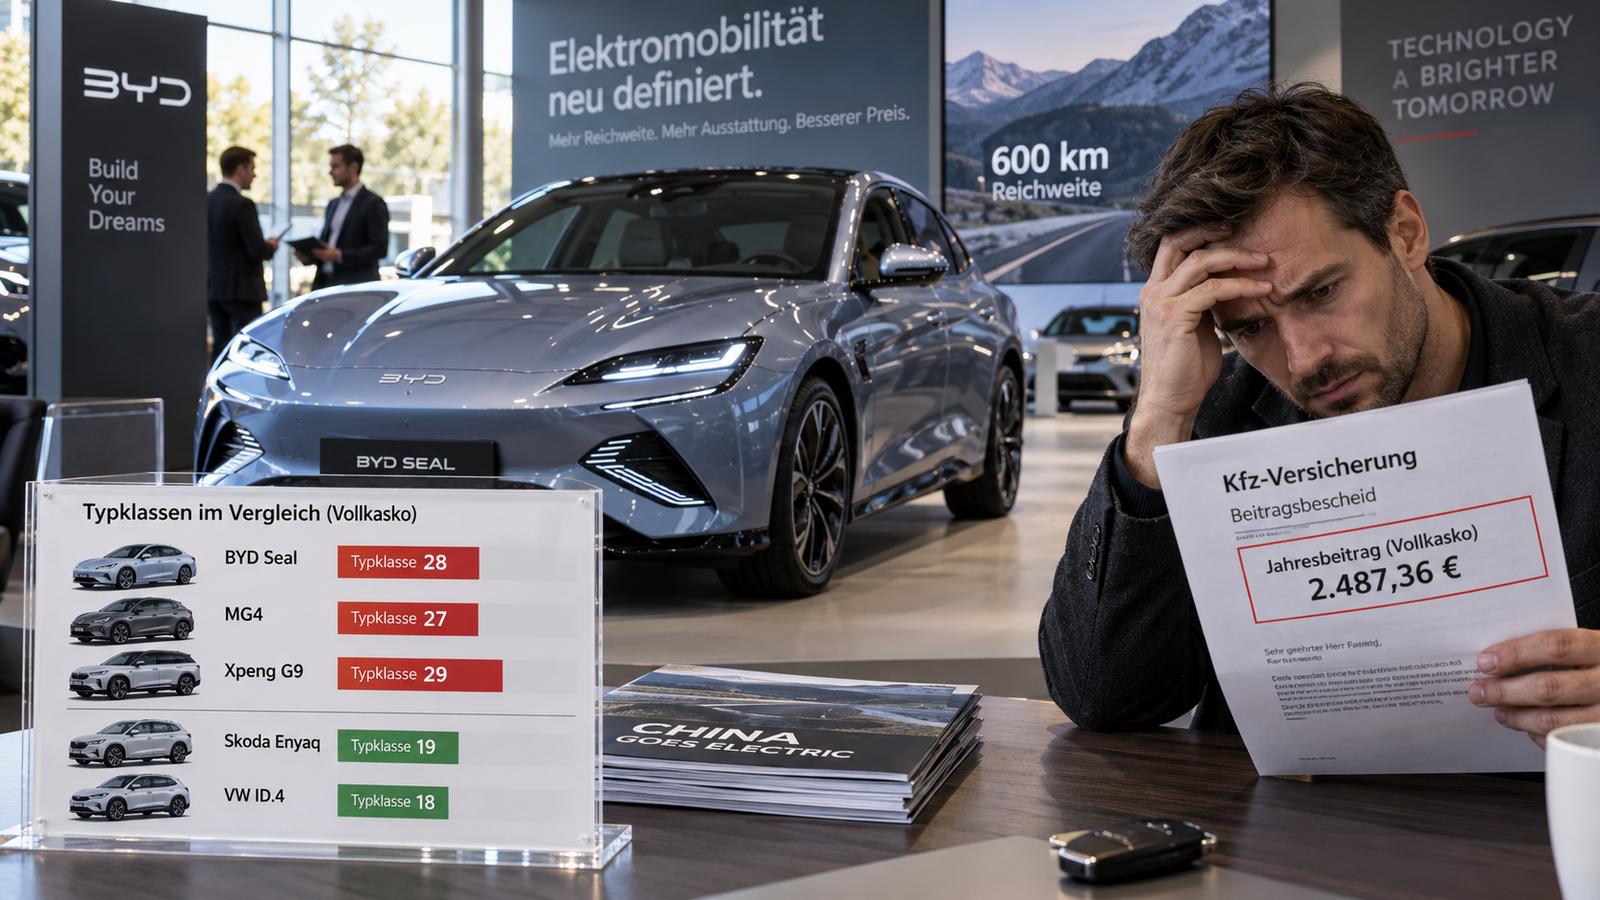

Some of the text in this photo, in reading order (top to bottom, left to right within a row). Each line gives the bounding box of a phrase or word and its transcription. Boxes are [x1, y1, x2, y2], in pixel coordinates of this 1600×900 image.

[548, 6, 825, 77] Elektromobilität
[1388, 14, 1574, 60] TECHNOLOGY
[1392, 50, 1558, 90] A BRIGHTER
[83, 67, 192, 107] BYD
[548, 64, 763, 117] neu definiert.
[1392, 82, 1555, 120] TOMORROW
[549, 104, 911, 149] Mehr Reichweite. Mehr Ausstattung. Besserer Preis.
[89, 158, 139, 181] Build
[991, 140, 1109, 176] 600 km
[89, 184, 136, 206] Your
[992, 177, 1102, 200] Reichweite
[89, 209, 166, 233] Dreams
[378, 373, 447, 385] BYD
[356, 455, 456, 471] BYD SEAL
[1223, 450, 1417, 493] Kfz-Versicherung
[83, 502, 418, 526] Typklassen im Vergleich (Vollkasko)
[1230, 486, 1377, 523] Beitragsbescheid
[225, 549, 298, 566] BYD Seal
[1266, 524, 1479, 574] Jahresbeitrag (Vollkasko)
[350, 553, 448, 573] Typklasse 28
[1309, 555, 1462, 603] 2.487,36 €
[225, 606, 264, 623] MG4
[350, 608, 448, 629] Typklasse 27
[1264, 647, 1284, 657] Sehr
[1286, 644, 1324, 656] geehrter
[1325, 642, 1345, 651] Herr
[225, 663, 304, 681] Xpeng G9
[350, 664, 448, 685] Typklasse 29
[224, 733, 321, 753] Skoda Enyaq
[632, 722, 800, 745] CHINA
[350, 738, 436, 755] Typklasse 19
[615, 735, 854, 759] GOES ELECTRIC
[224, 787, 285, 803] VW ID.4
[350, 793, 435, 811] Typklasse 18
